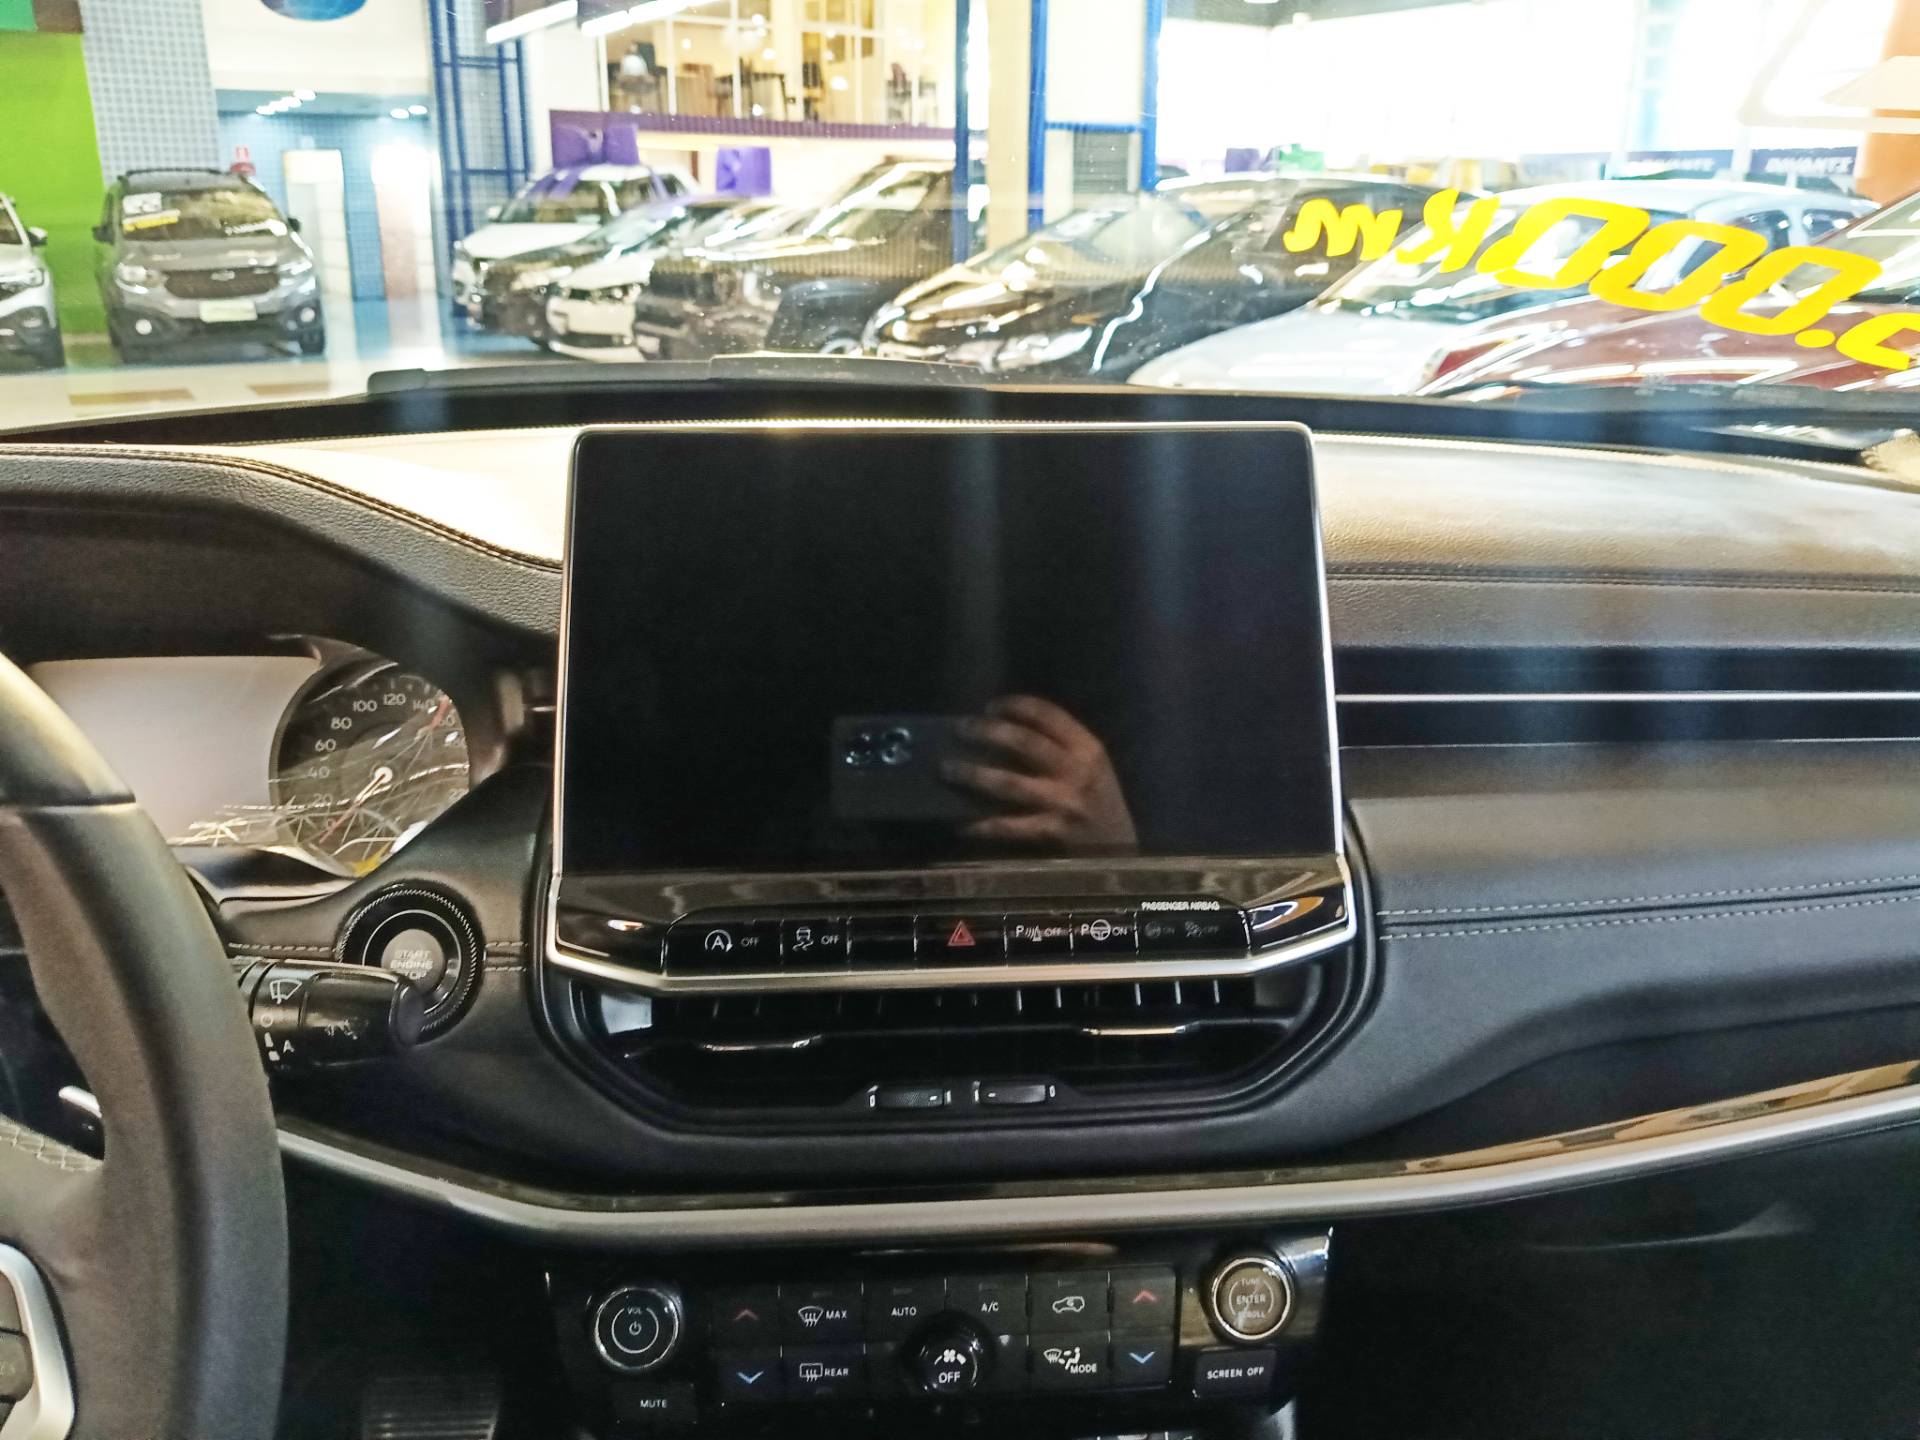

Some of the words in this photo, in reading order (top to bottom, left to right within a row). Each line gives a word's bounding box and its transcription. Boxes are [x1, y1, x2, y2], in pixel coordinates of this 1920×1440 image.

[383, 693, 406, 706] 120
[352, 701, 378, 712] 100
[330, 717, 352, 730] 80
[314, 739, 337, 752] 60
[308, 766, 330, 779] 40
[312, 793, 334, 807] 20
[1141, 901, 1189, 911] PASSENGER
[1190, 901, 1220, 911] AIRBAG
[1015, 925, 1025, 938] P
[1043, 927, 1062, 937] OFF
[1081, 924, 1090, 936] P
[1112, 926, 1128, 936] ON
[740, 937, 760, 947] OFF
[820, 934, 840, 945] OFF
[394, 949, 432, 959] START
[390, 959, 434, 970] ENGINE
[283, 1040, 295, 1053] A
[1241, 1277, 1261, 1286] TUNE
[1236, 1294, 1266, 1304] ENTER
[626, 1307, 643, 1315] VOL
[891, 1306, 918, 1316] AUTO
[980, 1301, 1000, 1313] A/C
[825, 1310, 848, 1320] MAX
[824, 1367, 849, 1377] REAR
[1070, 1363, 1097, 1374] MODE
[1207, 1368, 1243, 1379] SCREEN
[1246, 1366, 1265, 1377] OFF
[938, 1371, 961, 1384] OFF
[640, 1399, 667, 1408] MUTE
